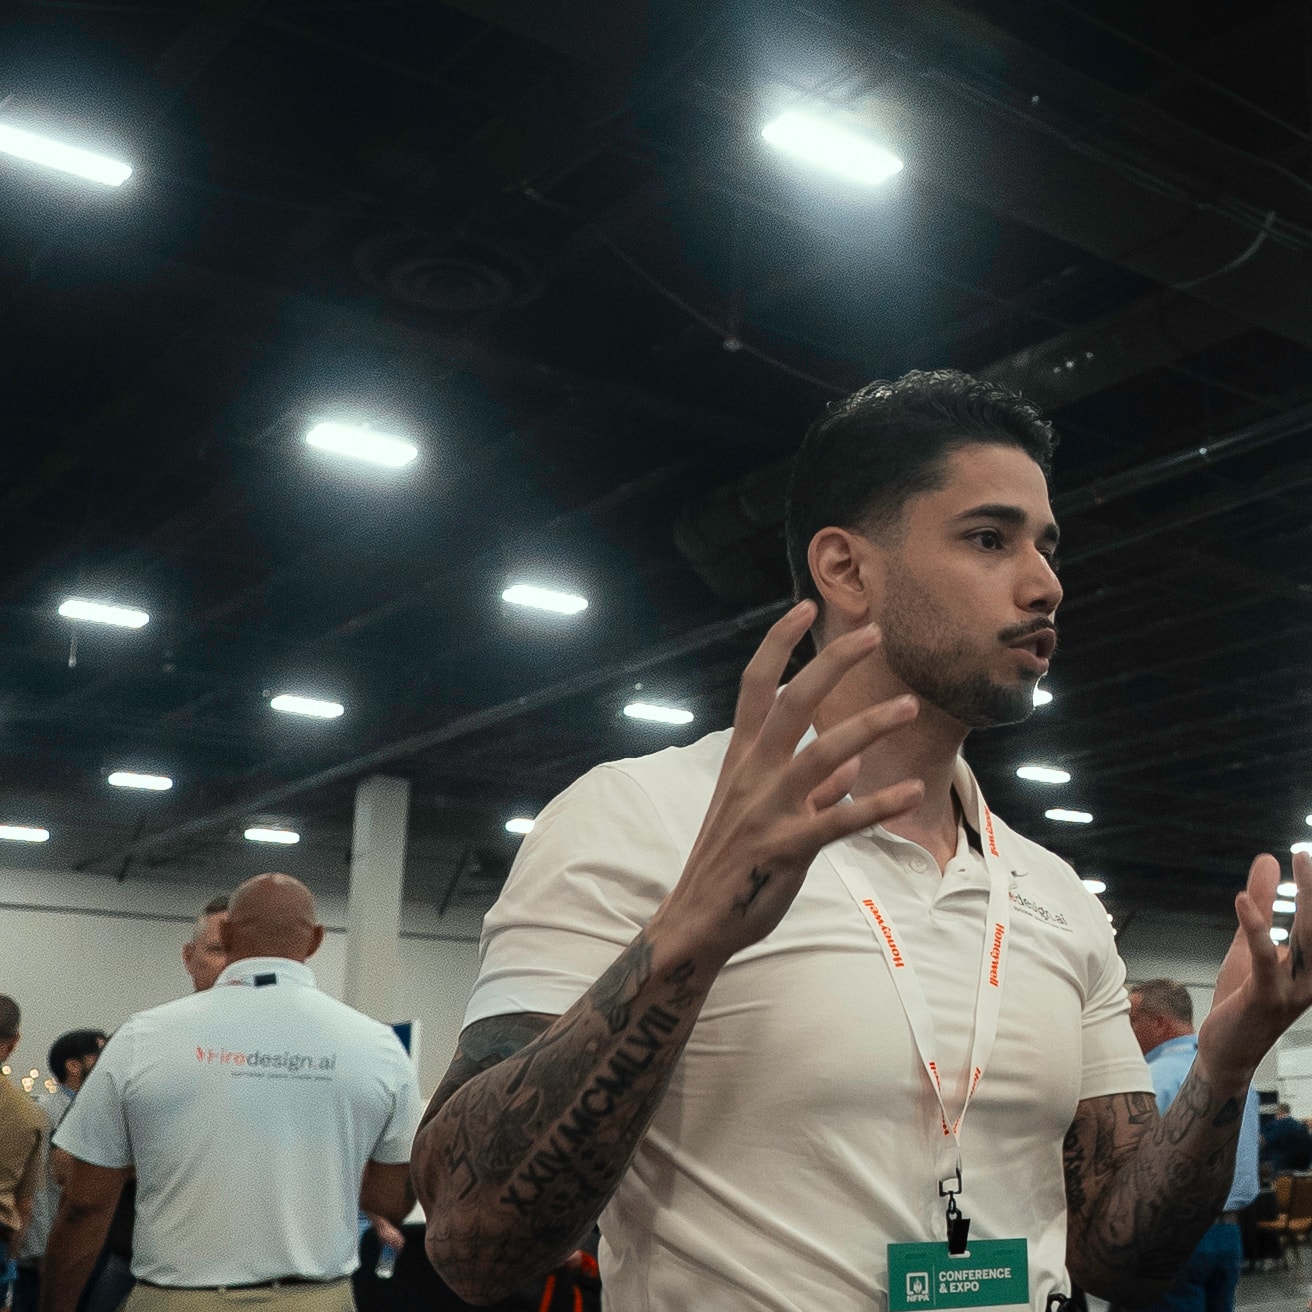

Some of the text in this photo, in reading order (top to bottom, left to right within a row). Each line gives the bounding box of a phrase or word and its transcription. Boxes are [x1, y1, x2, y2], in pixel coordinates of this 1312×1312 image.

[862, 899, 904, 968] Honeywell
[989, 923, 1005, 987] Honeywell
[939, 1268, 1011, 1282] CONFERENCE
[939, 1281, 980, 1294] & EXPO
[906, 1293, 930, 1303] NFPA
